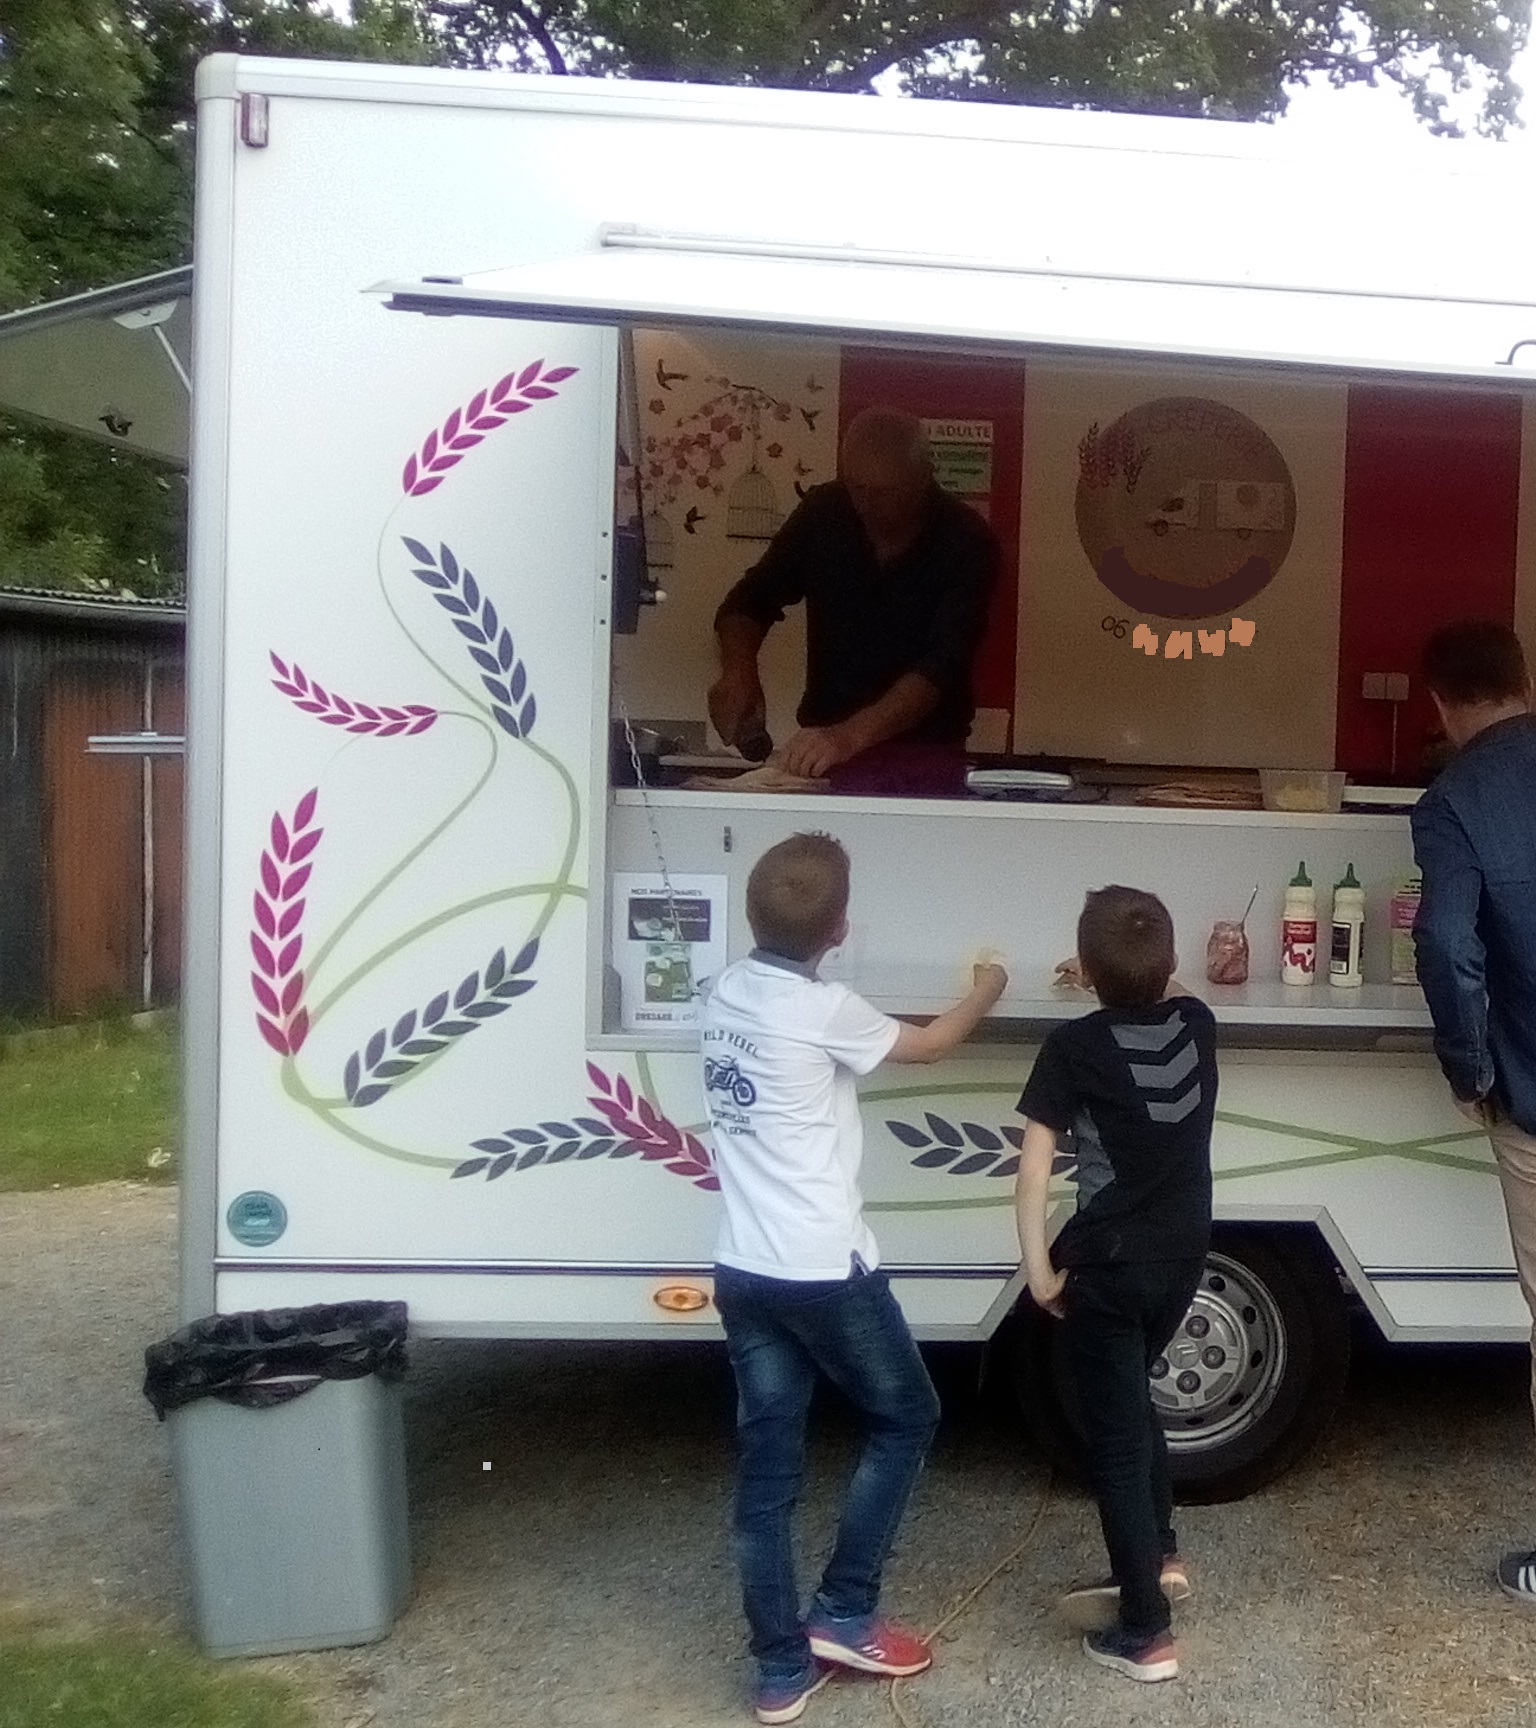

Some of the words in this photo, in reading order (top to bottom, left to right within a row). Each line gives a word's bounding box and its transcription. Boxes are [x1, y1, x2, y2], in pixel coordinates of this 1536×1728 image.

[937, 425, 991, 438] ADULTE
[1101, 615, 1130, 639] 06
[727, 1032, 758, 1058] REBEL
